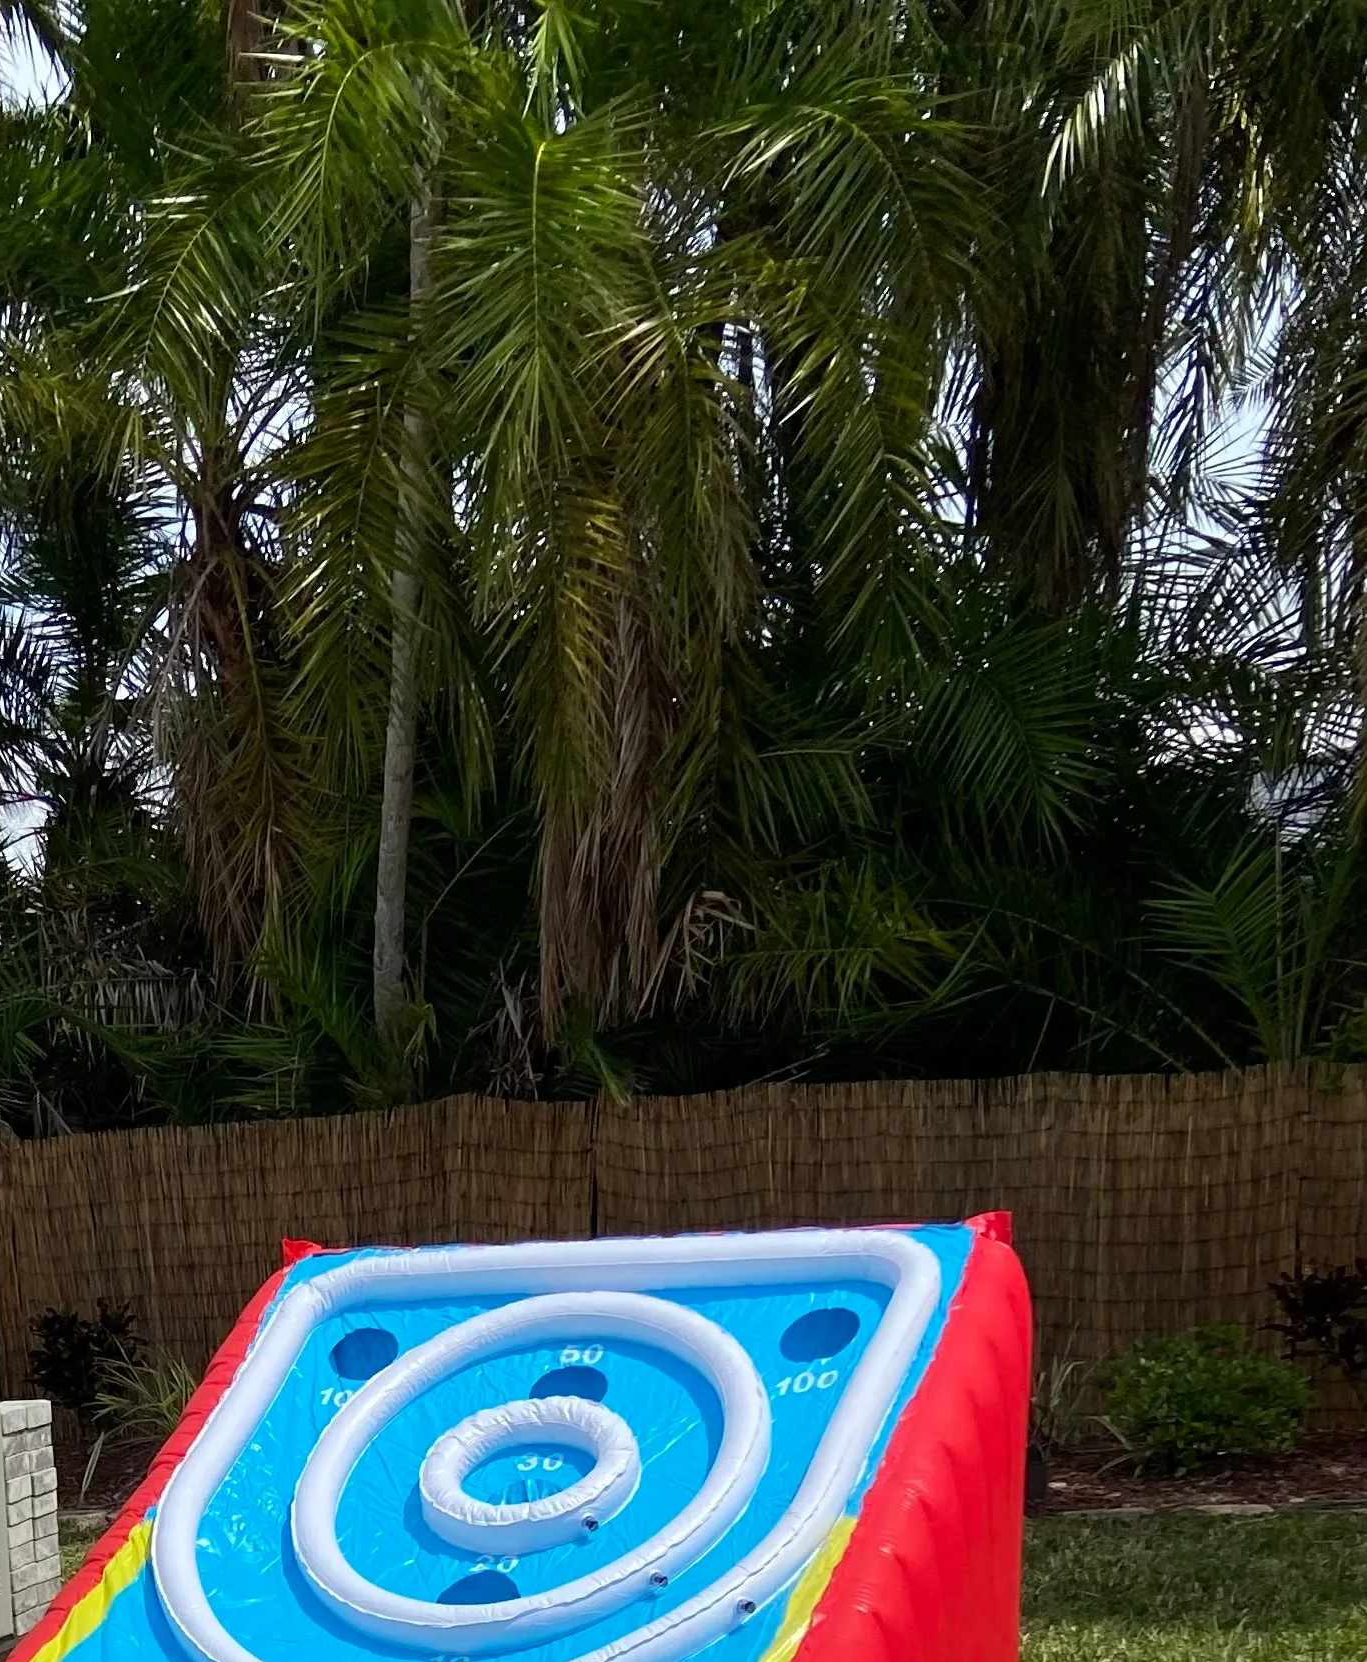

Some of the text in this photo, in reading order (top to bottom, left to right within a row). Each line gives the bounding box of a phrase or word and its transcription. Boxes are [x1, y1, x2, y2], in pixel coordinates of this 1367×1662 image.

[559, 1344, 604, 1366] 50
[775, 1370, 839, 1396] 100
[320, 1387, 354, 1408] 10
[516, 1452, 564, 1471] 30
[469, 1554, 519, 1573] 20
